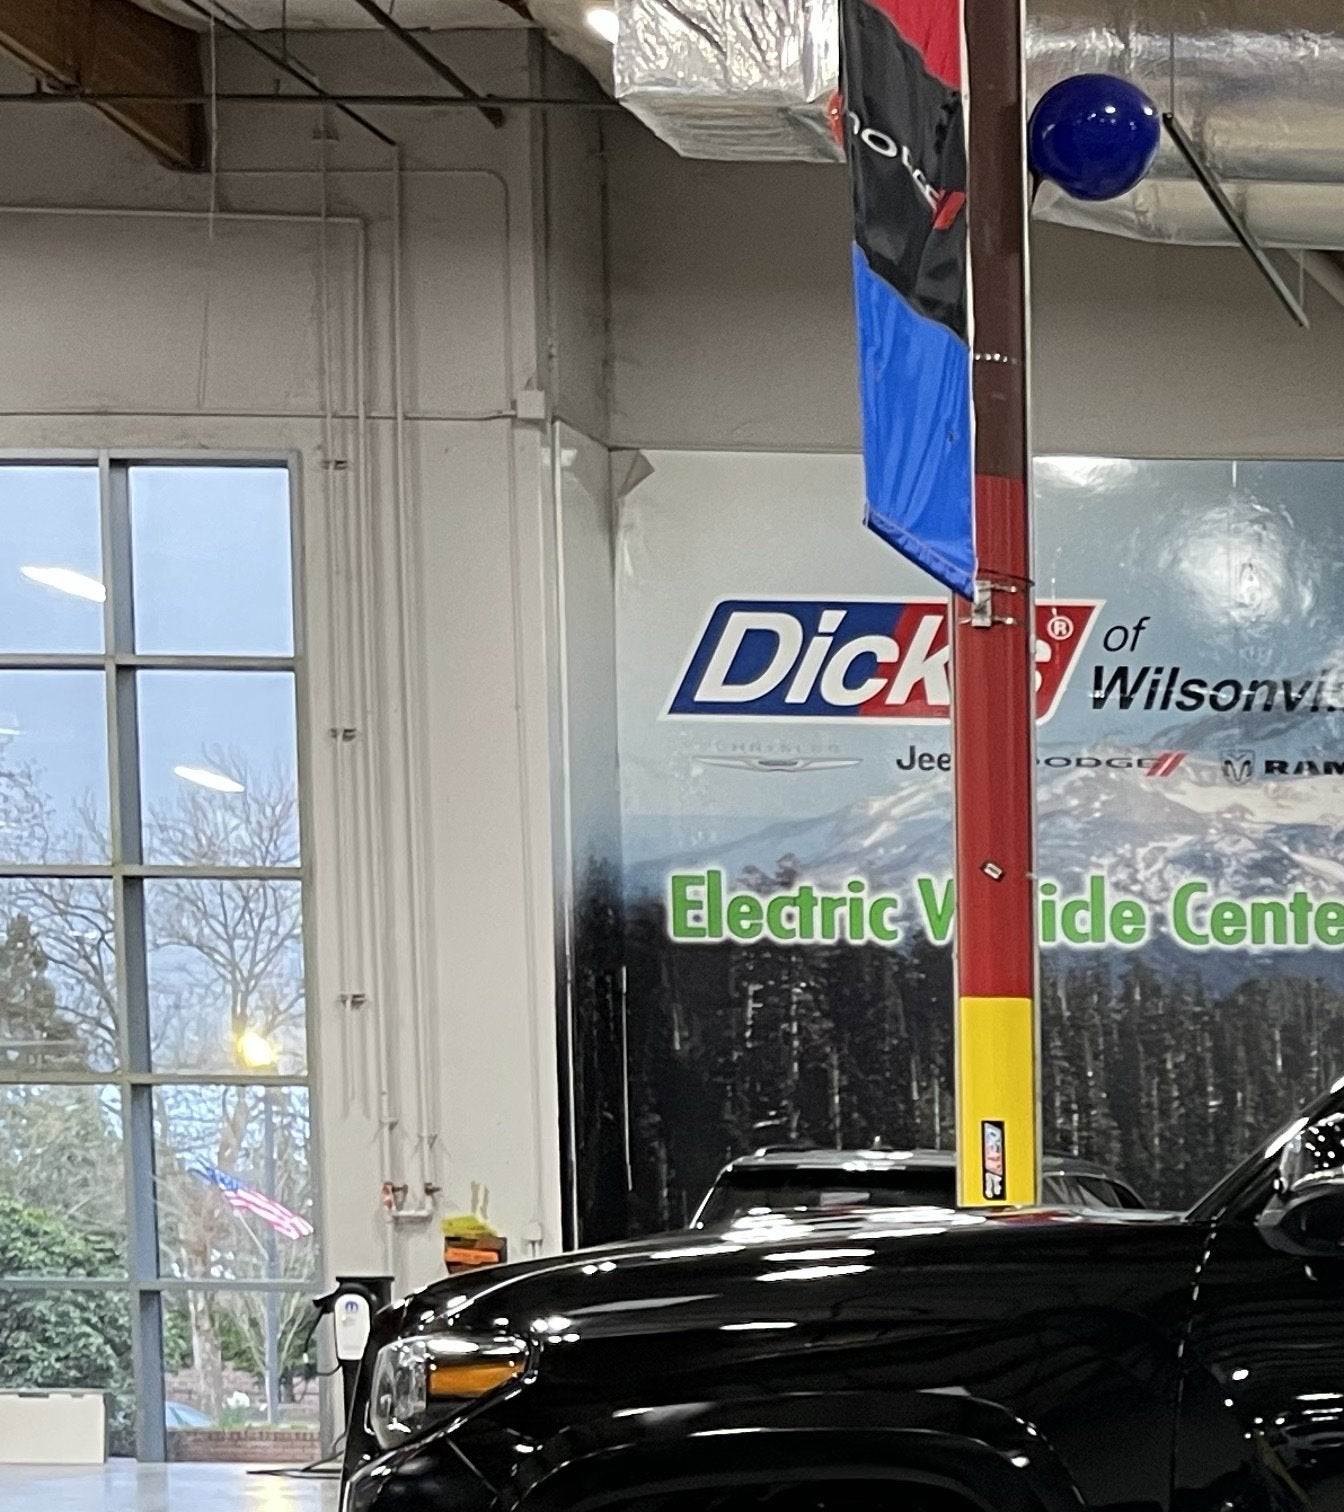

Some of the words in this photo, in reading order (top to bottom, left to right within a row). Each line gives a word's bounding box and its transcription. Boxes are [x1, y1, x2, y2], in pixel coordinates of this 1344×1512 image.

[1103, 616, 1150, 652] of
[896, 745, 952, 771] Jee
[1036, 756, 1160, 769] ODGE
[671, 869, 898, 941] Electric
[917, 875, 1146, 943] Vicle
